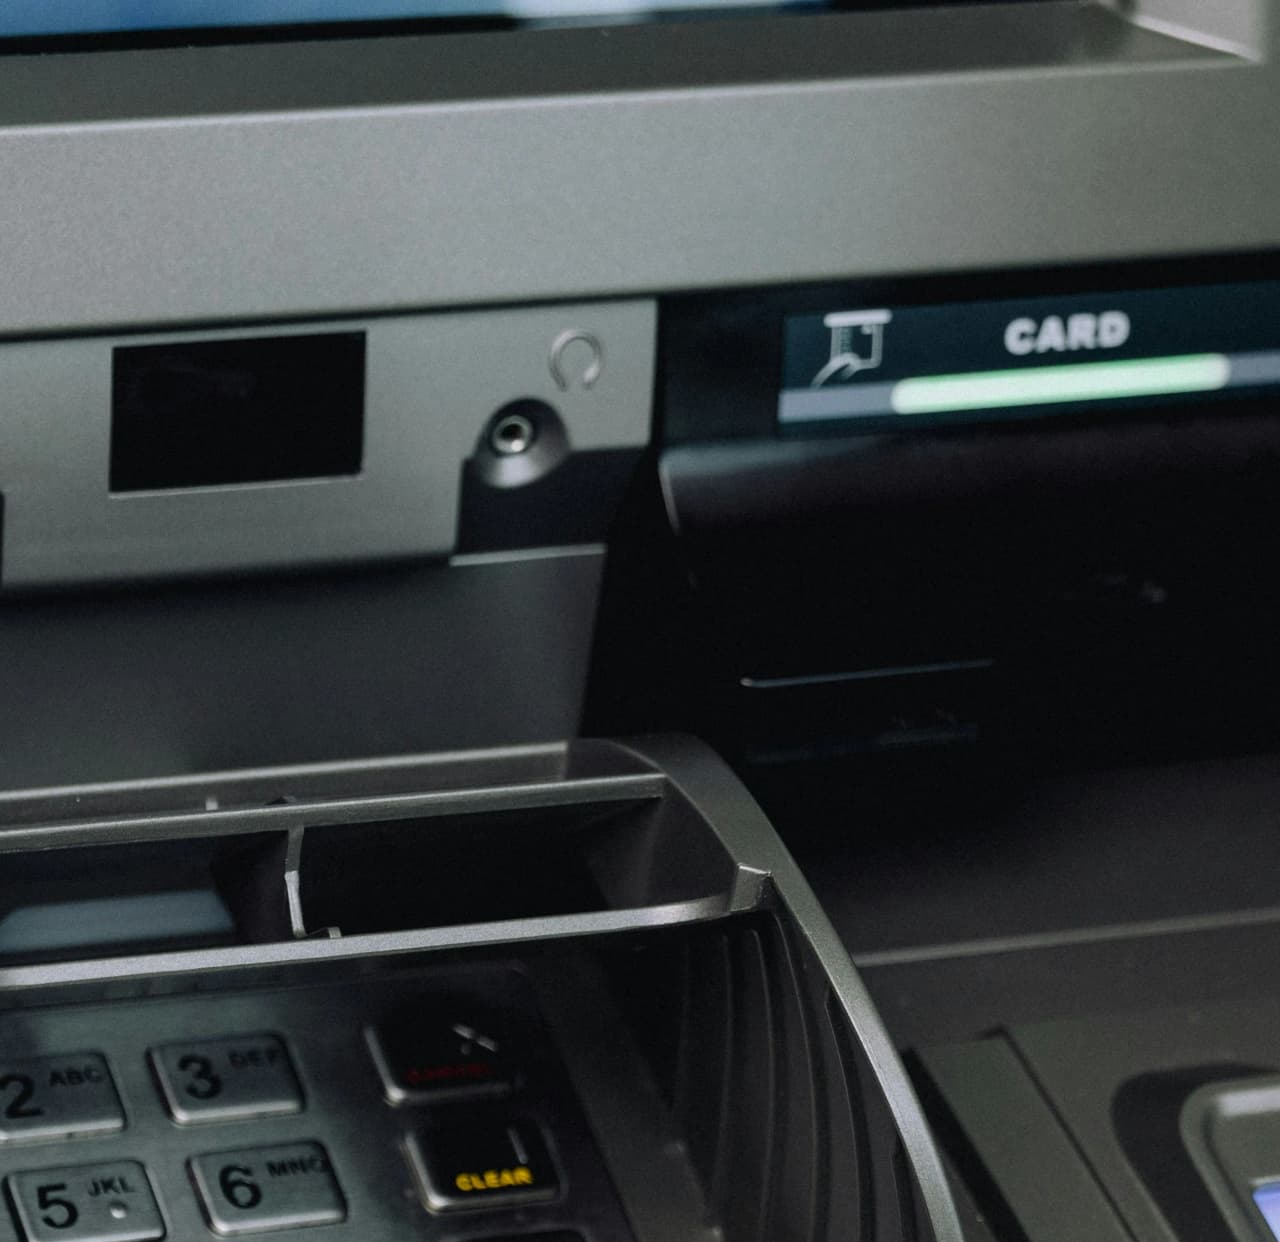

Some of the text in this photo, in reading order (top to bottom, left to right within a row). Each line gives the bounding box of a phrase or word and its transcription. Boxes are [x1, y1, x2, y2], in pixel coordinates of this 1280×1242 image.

[1004, 310, 1131, 355] CARD
[48, 1064, 106, 1088] ABC
[177, 1053, 221, 1100] 3
[219, 1164, 262, 1210] 6
[455, 1166, 534, 1192] CLEAR
[36, 1174, 138, 1230] 5 JKL
